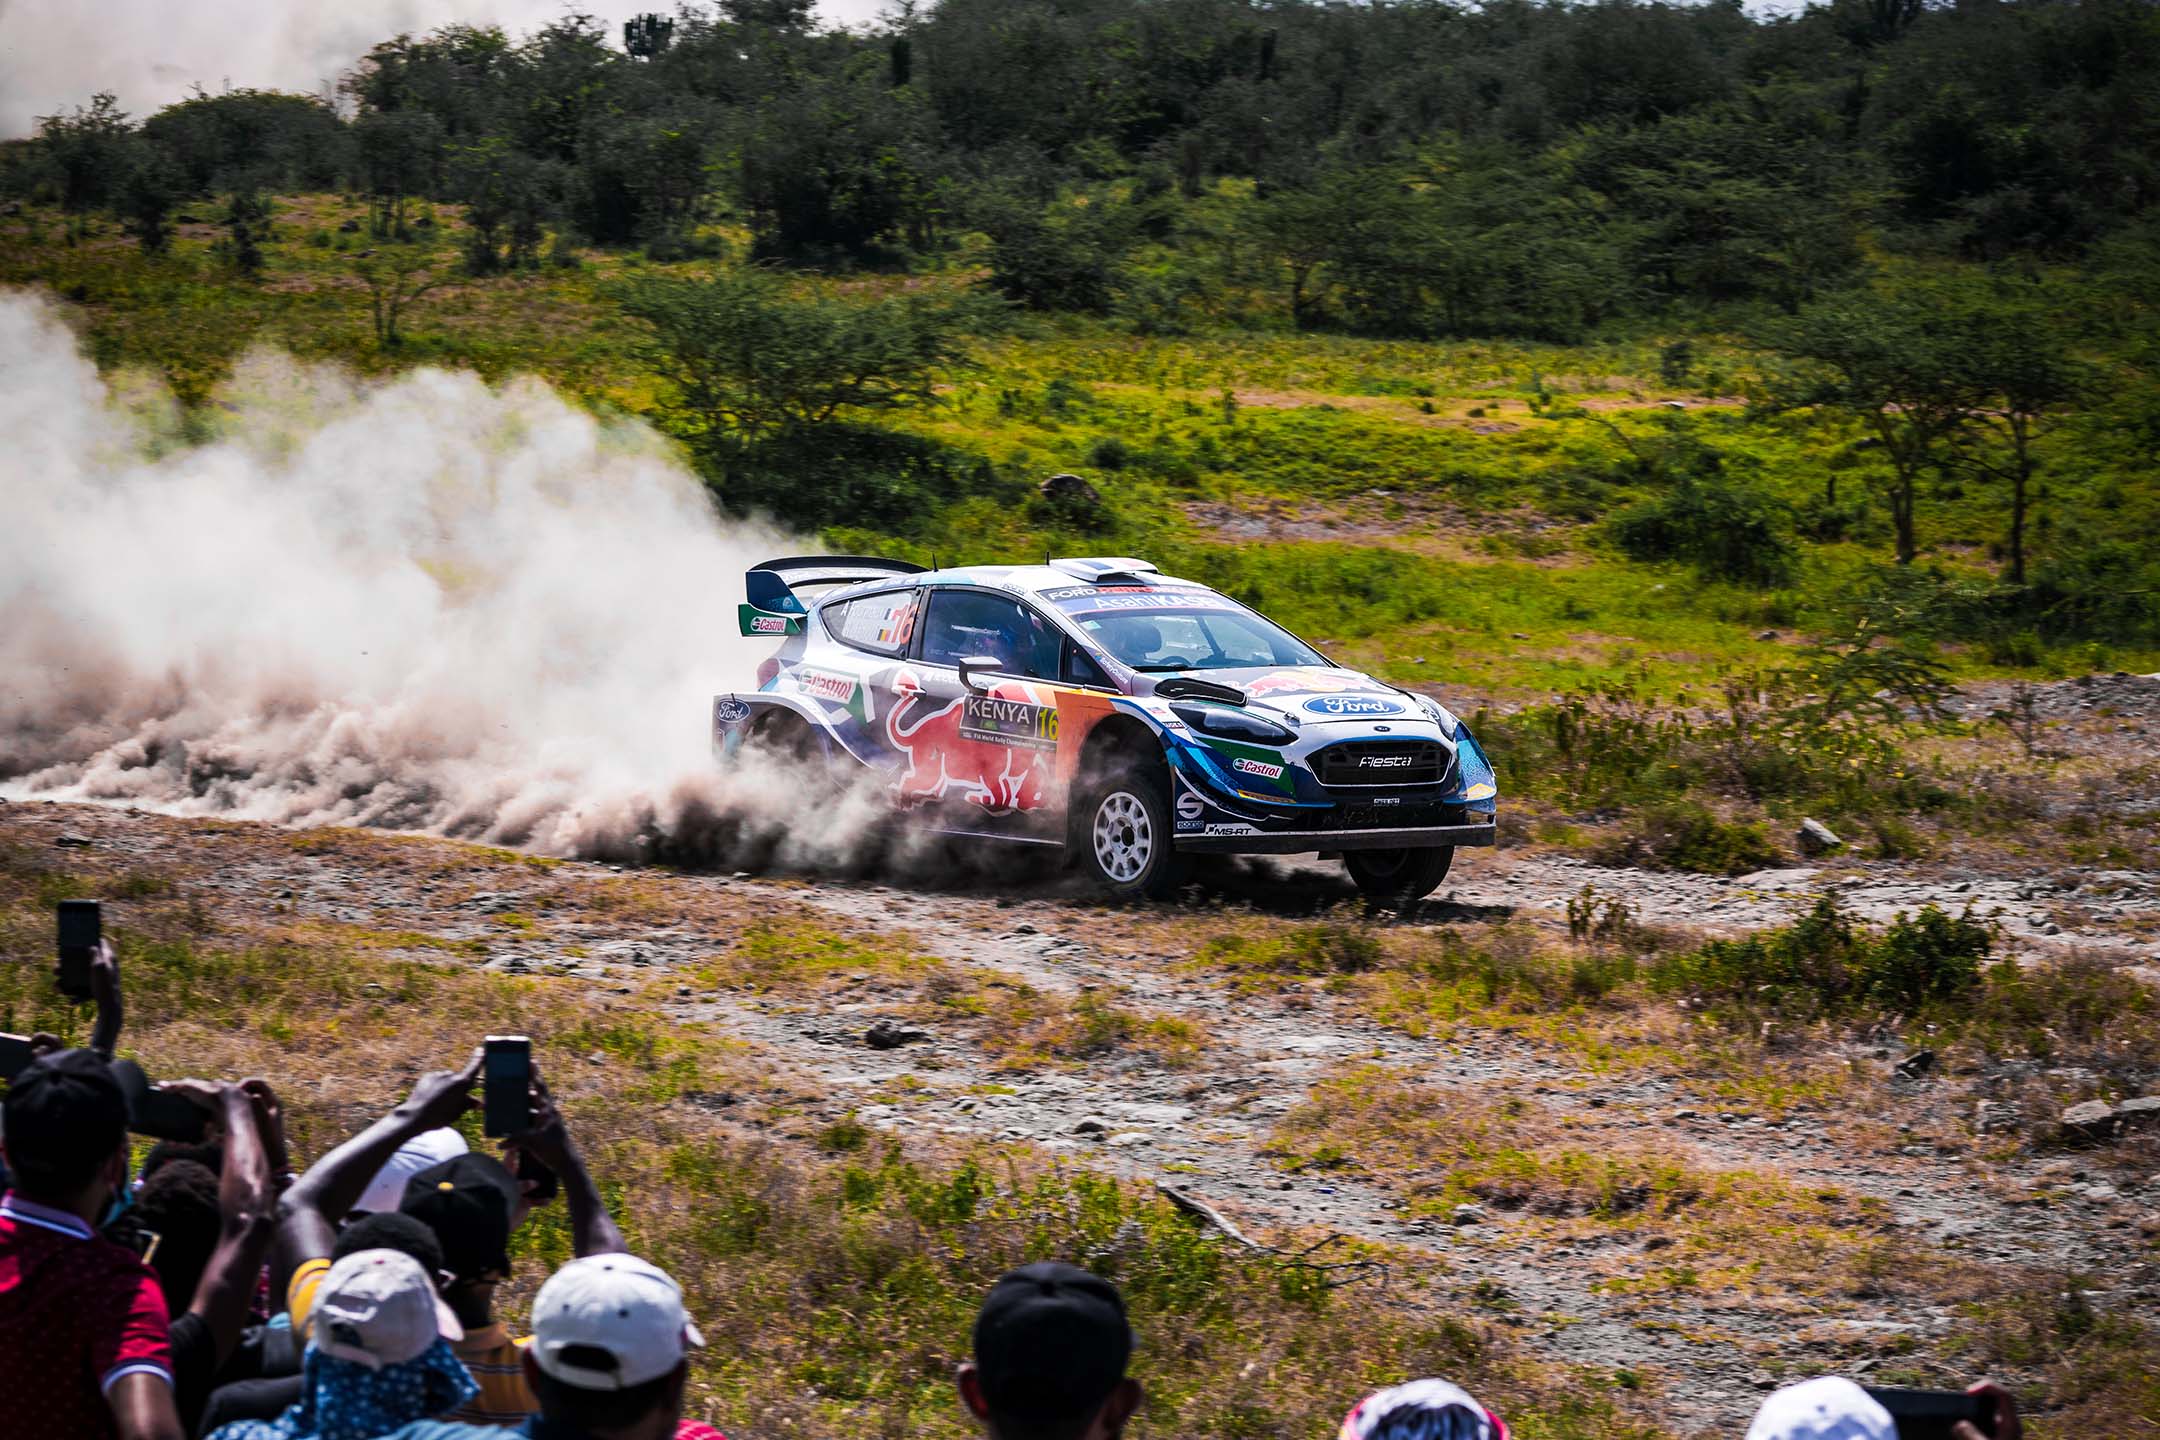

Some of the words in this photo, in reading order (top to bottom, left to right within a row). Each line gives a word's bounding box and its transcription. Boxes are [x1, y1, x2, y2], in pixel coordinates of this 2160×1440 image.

[1048, 586, 1096, 600] FORD
[759, 618, 785, 631] Castrol
[810, 672, 852, 700] Castrol
[719, 701, 744, 719] Ford
[968, 698, 1030, 724] KENYA
[1323, 697, 1390, 713] Ford
[1040, 708, 1058, 740] 16
[1244, 761, 1280, 777] Castrol
[1358, 756, 1412, 768] Fiesta
[1214, 828, 1252, 836] MS-RT
